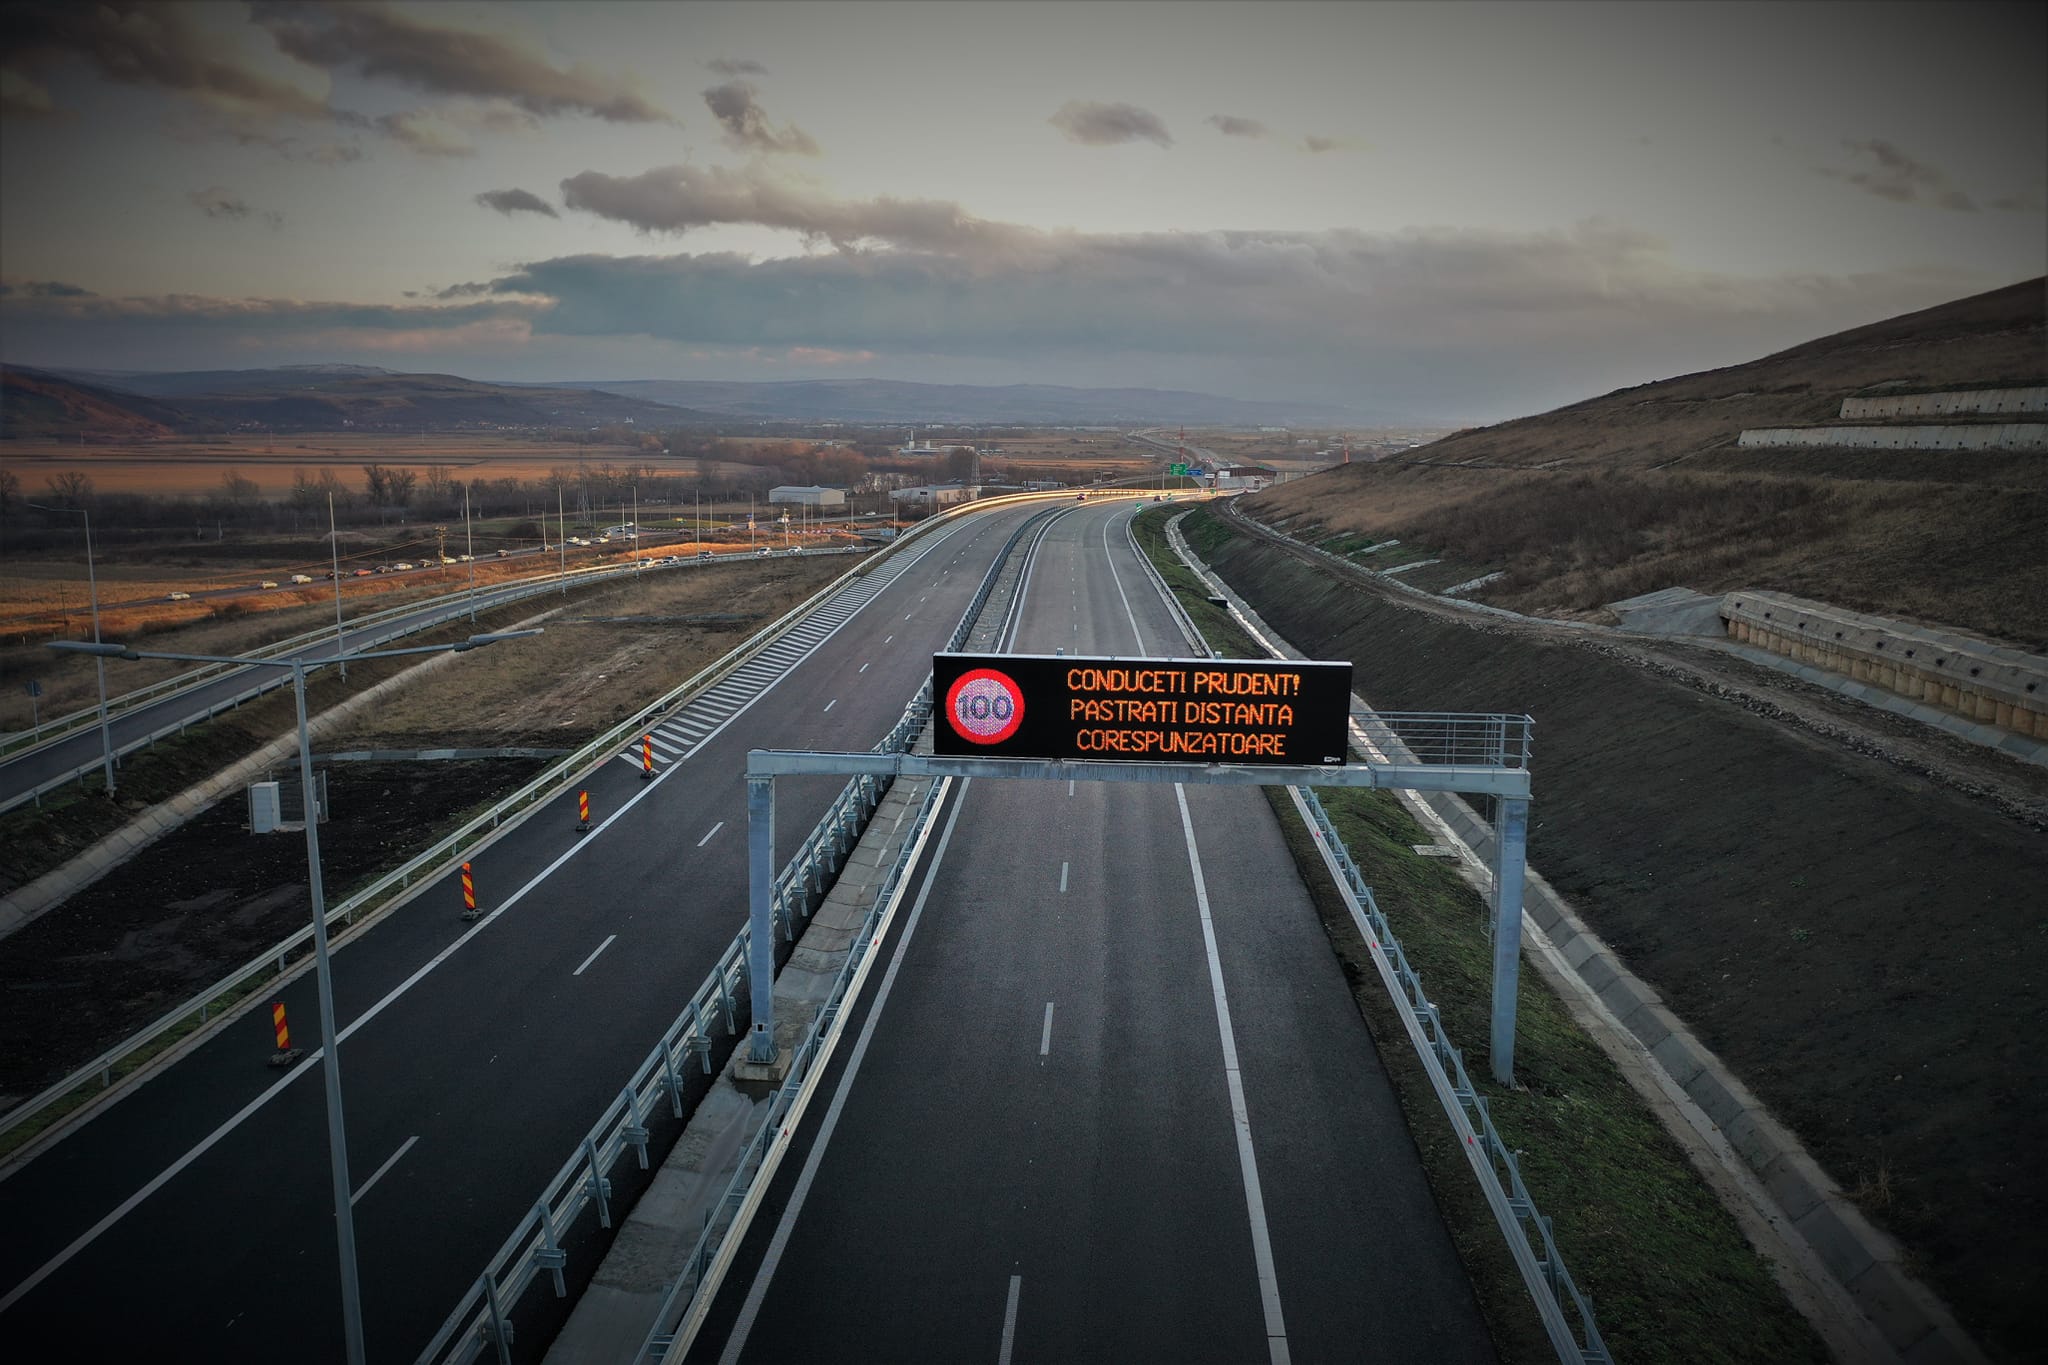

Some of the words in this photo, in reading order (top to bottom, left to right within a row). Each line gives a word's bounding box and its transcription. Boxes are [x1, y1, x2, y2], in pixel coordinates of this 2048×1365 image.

[1067, 669, 1187, 693] CONDUCETI
[1193, 671, 1301, 696] PRUDENT!
[958, 695, 1013, 720] 100
[1071, 699, 1178, 723] PASTRATI
[1184, 701, 1294, 726] DISTANTA
[1076, 728, 1287, 756] CORESPUNZATOARE
